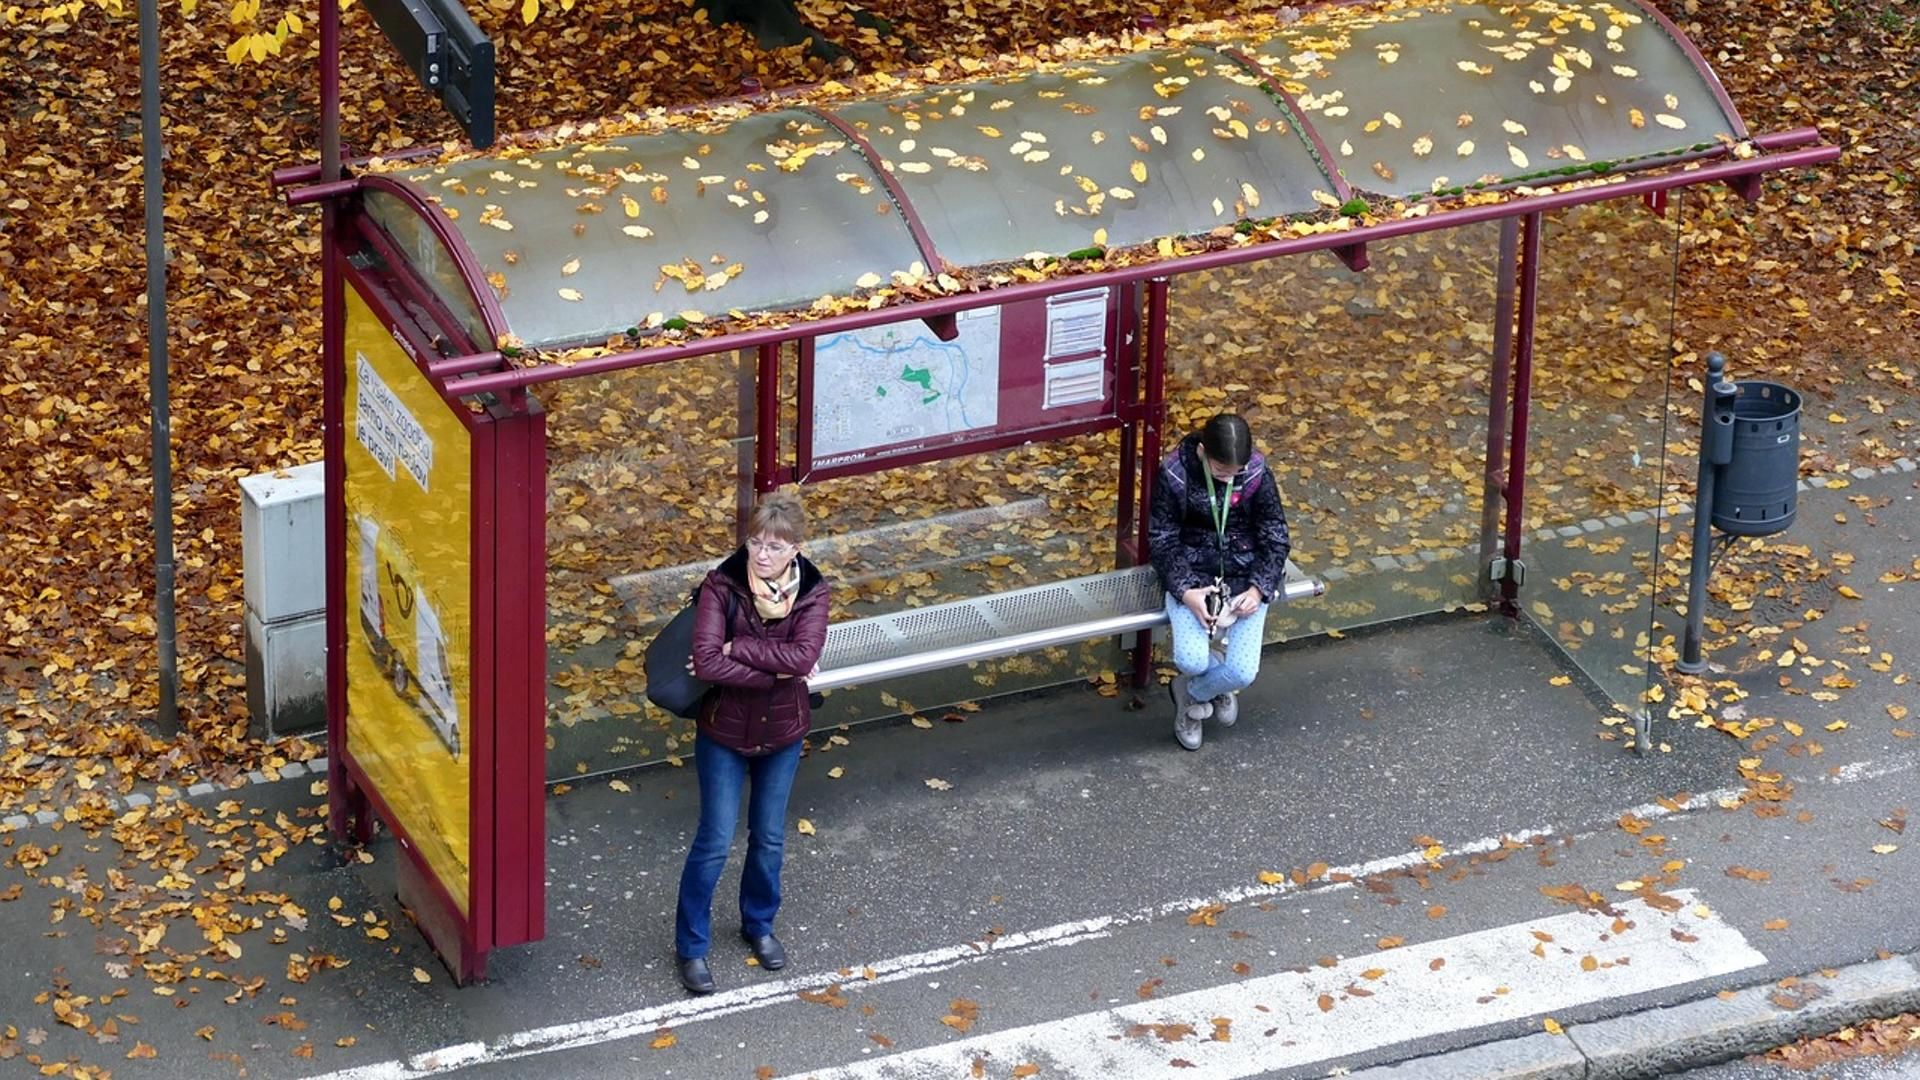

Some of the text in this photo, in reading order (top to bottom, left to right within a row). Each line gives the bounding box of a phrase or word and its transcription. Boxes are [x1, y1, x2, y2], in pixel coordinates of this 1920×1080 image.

[358, 355, 369, 385] Za
[359, 392, 383, 431] samo
[385, 425, 397, 450] en
